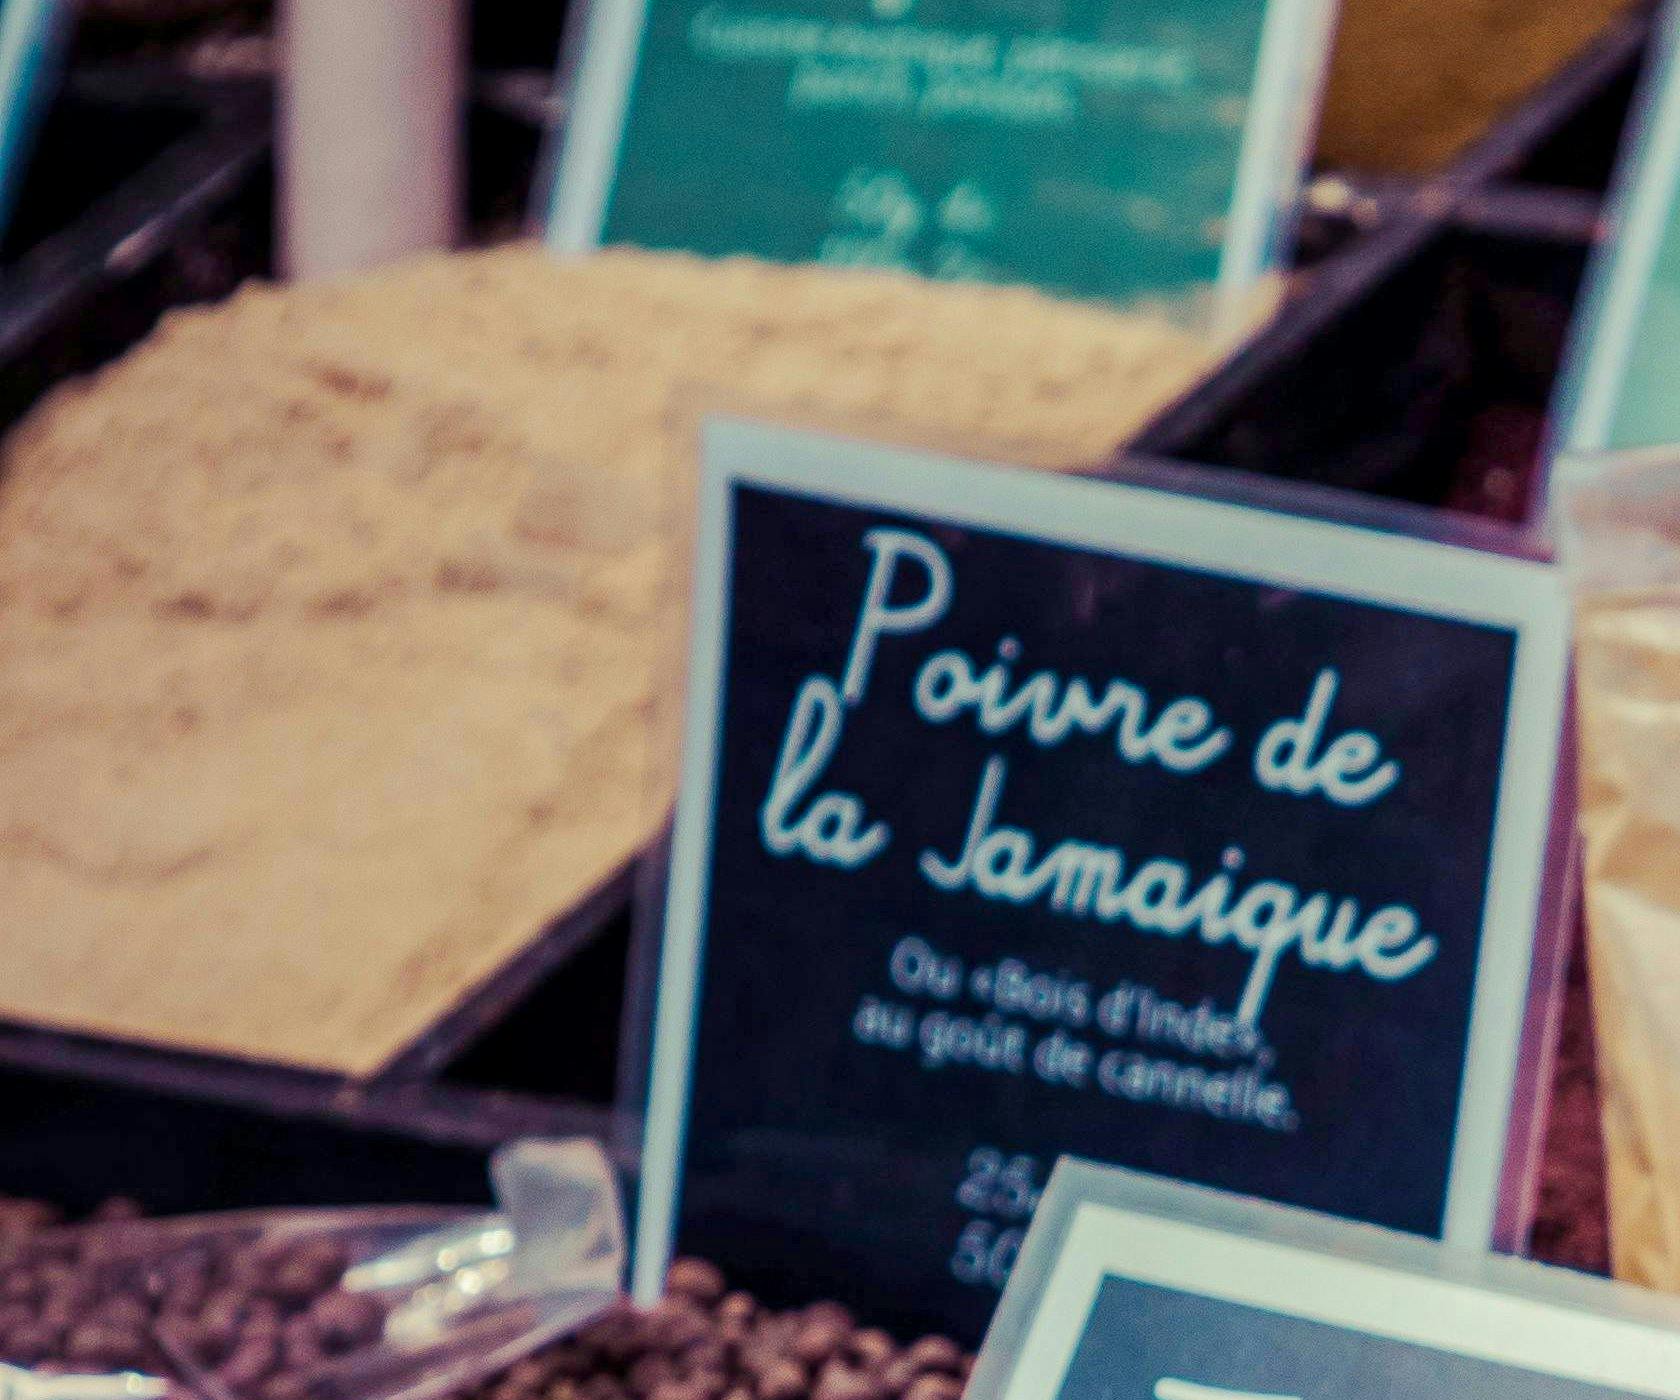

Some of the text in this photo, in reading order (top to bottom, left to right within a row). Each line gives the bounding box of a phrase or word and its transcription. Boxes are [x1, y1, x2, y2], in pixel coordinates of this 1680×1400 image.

[841, 528, 1400, 806] Poivre de
[758, 671, 889, 870] la
[889, 935, 963, 998] Ou
[852, 996, 914, 1048] au
[1033, 1027, 1092, 1088] de
[956, 1146, 1044, 1218] 25
